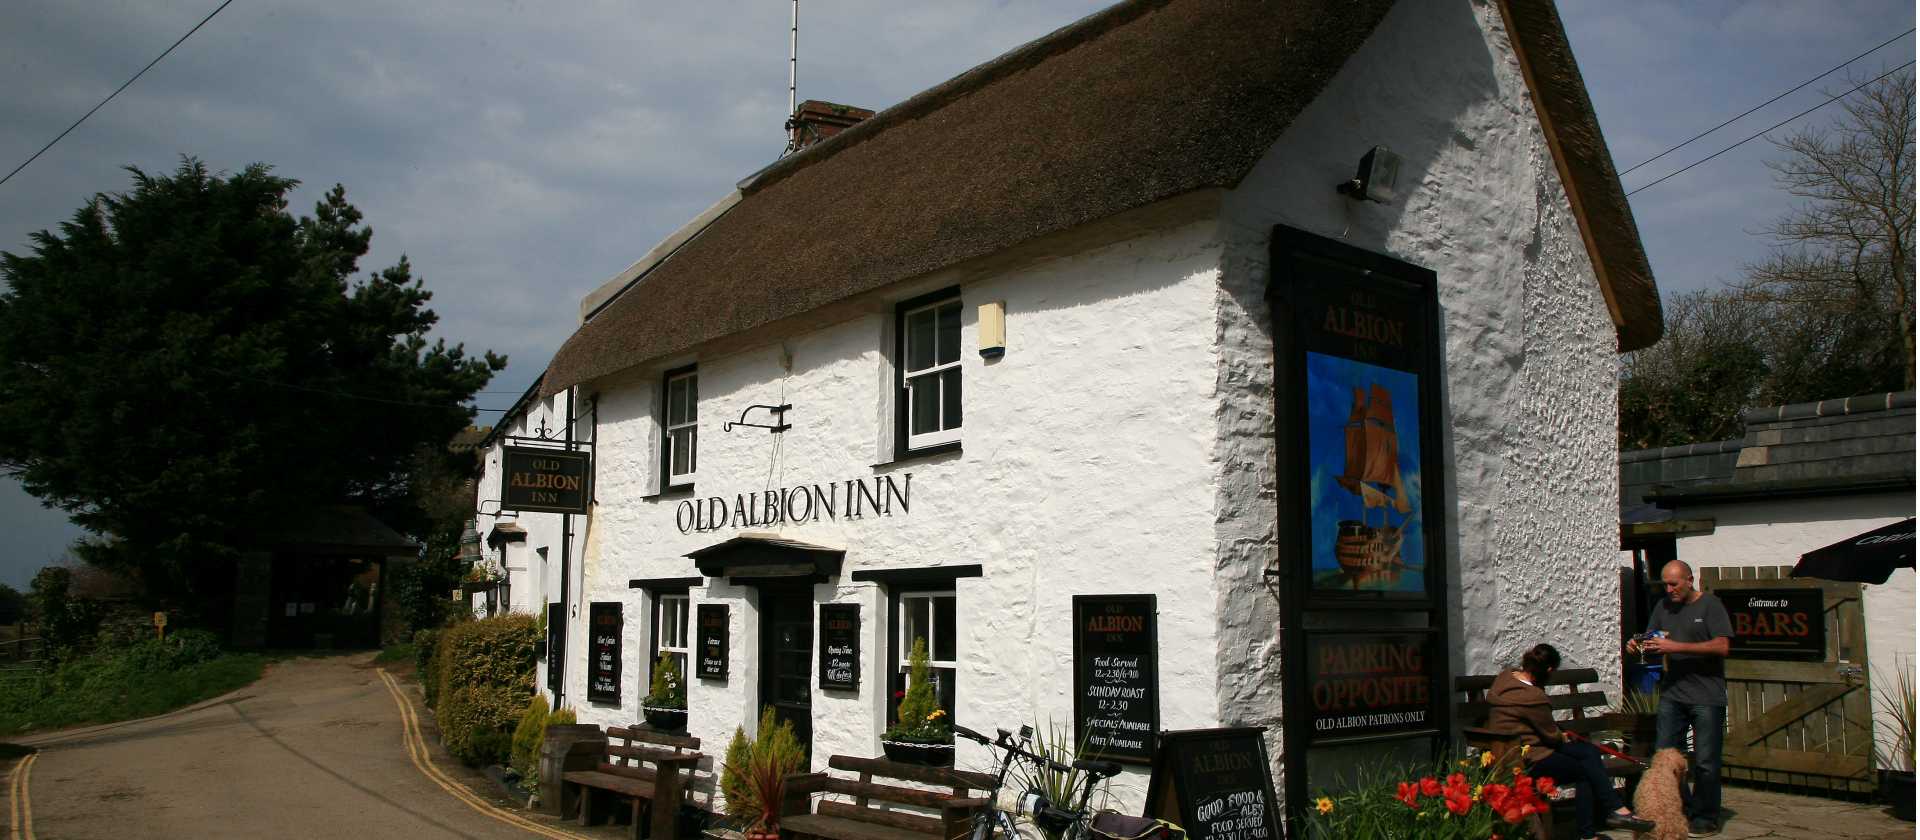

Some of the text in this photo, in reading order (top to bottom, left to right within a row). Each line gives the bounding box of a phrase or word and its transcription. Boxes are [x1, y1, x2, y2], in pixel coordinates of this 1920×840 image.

[1323, 304, 1405, 347] ALBION
[530, 459, 561, 471] OLD
[511, 471, 581, 490] ALBION
[530, 492, 559, 505] INN
[677, 473, 912, 534] OLD ALBION INN
[1748, 597, 1789, 608] Entrance to
[1088, 615, 1143, 632] ALBION
[1732, 610, 1809, 637] BARS
[1094, 656, 1138, 669] Food Served
[1319, 643, 1423, 674] PARKING
[1088, 685, 1146, 699] SUNDAY ROAST
[1313, 676, 1430, 710] OPPOSITE
[1085, 716, 1119, 729] SPECIALS
[1315, 710, 1426, 731] OLD ALBION PATRONS ONLY
[1192, 752, 1253, 774] ALBION
[1197, 789, 1265, 822] GOOD FOOD &
[1211, 816, 1263, 834] FOOD SERVED
